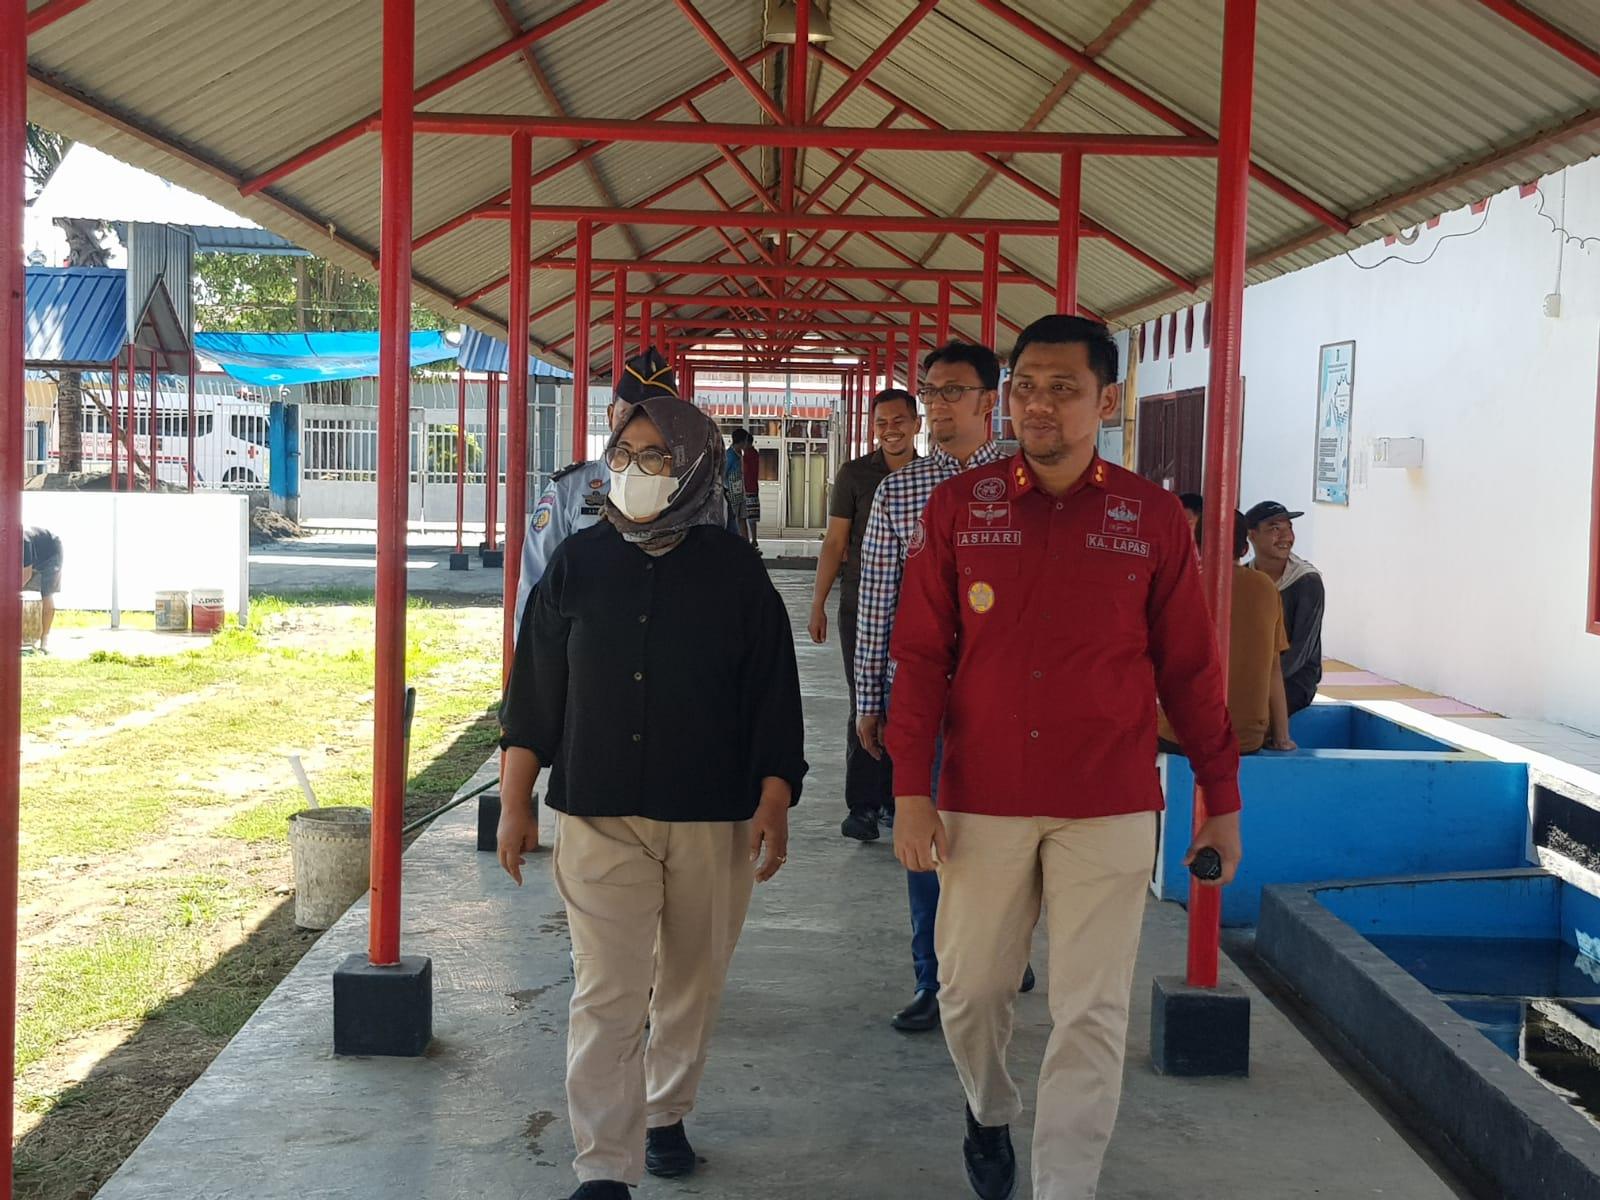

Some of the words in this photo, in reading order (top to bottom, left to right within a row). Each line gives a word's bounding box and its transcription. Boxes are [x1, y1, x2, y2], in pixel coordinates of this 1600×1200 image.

[960, 532, 1018, 544] ASHARI
[1088, 535, 1108, 548] KA.
[1113, 538, 1147, 555] LAPAS
